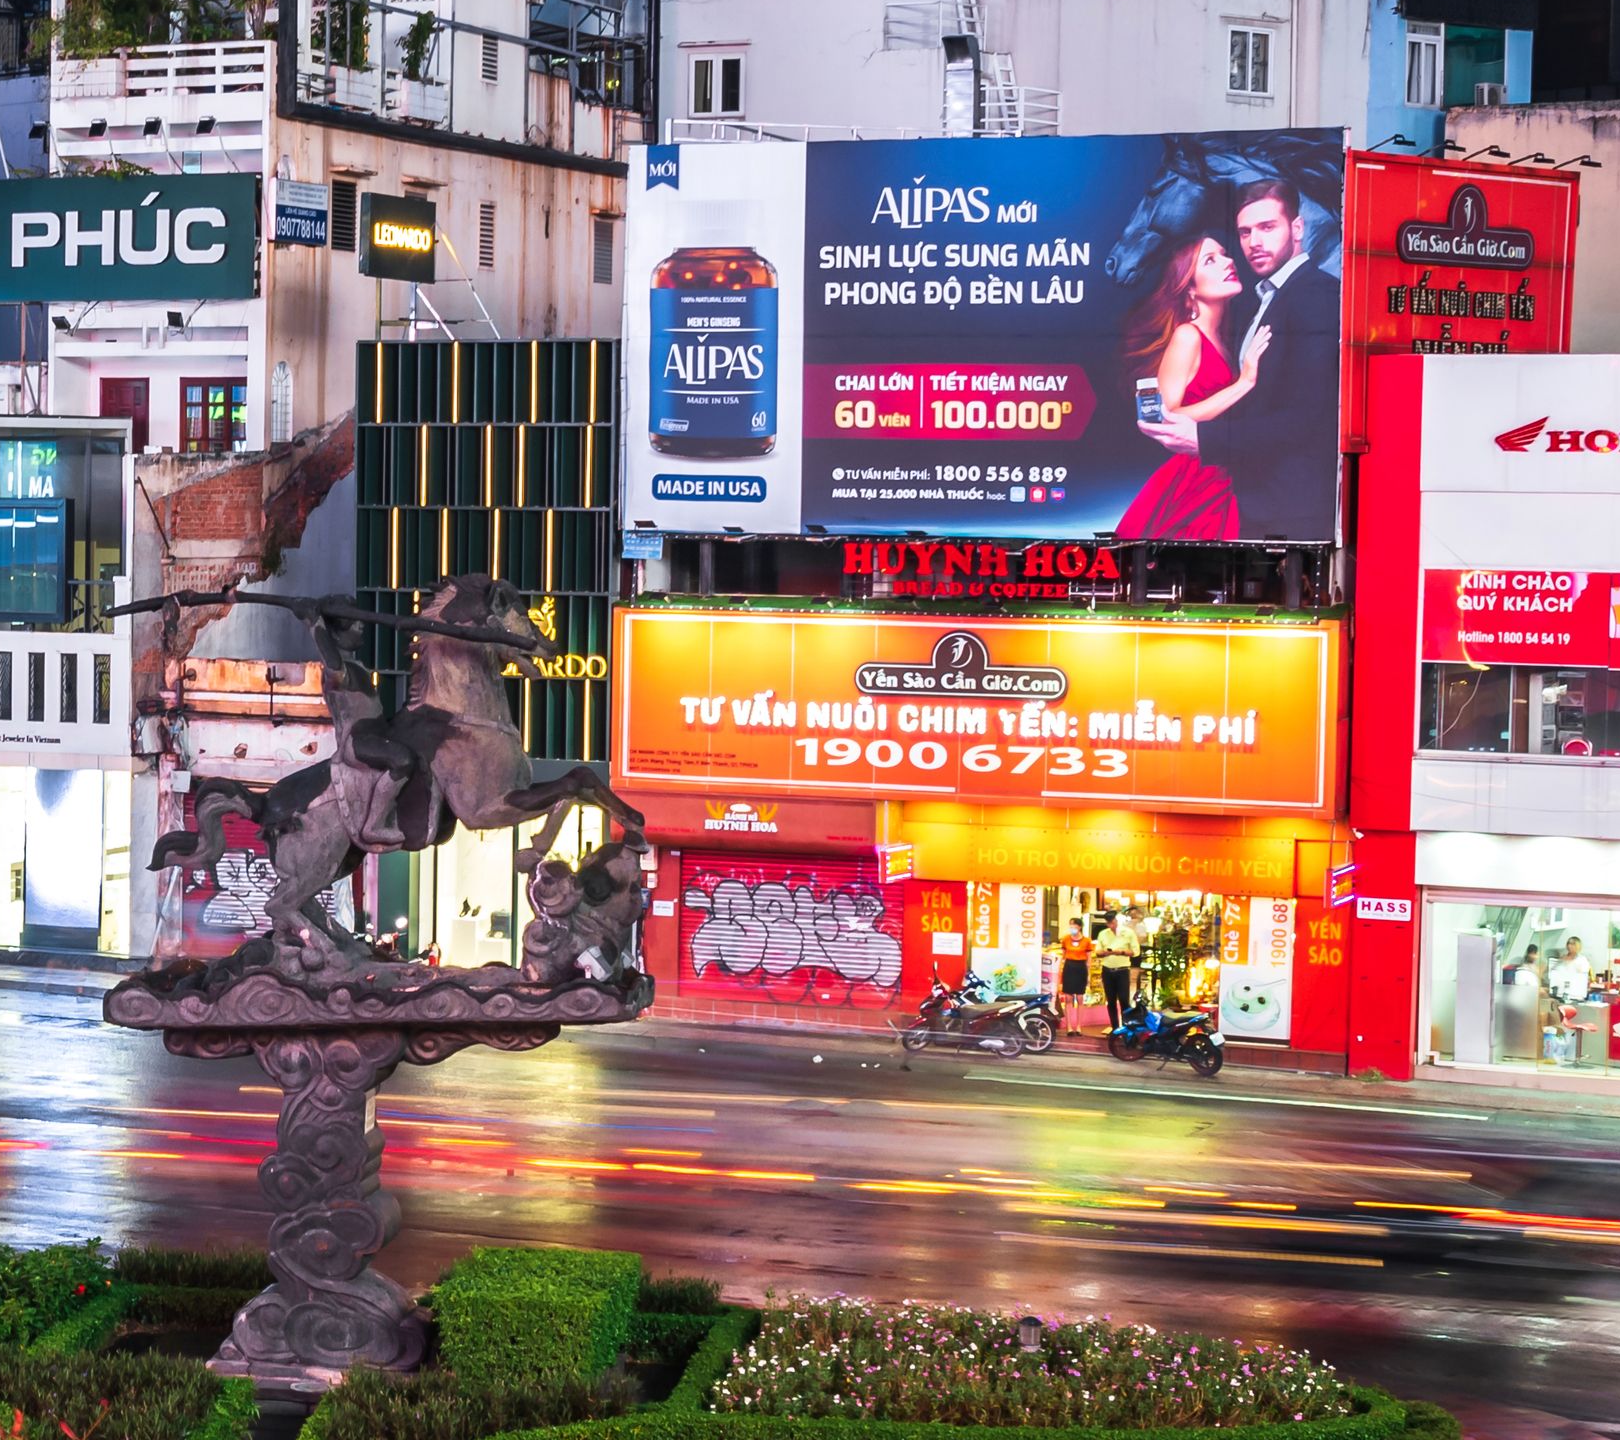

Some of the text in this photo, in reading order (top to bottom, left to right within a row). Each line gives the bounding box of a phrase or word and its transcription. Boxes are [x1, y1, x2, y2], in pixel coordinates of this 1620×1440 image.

[649, 159, 676, 177] MỚI
[10, 191, 226, 268] PHÚC
[276, 216, 326, 240] 0907788144
[819, 238, 1091, 274] SINH LỰC SUNG MÃN
[1406, 230, 1526, 260] Yến Sào Cần Giờ.Com
[824, 274, 1084, 310] PHONG ĐỘ BỀN LÂU
[835, 372, 913, 392] CHAI LỚN
[930, 371, 1068, 396] TIẾT KIỆM NGAY
[834, 400, 911, 429] 60 VIÊN
[657, 480, 761, 497] MADE IN USA
[891, 579, 1069, 600] BREAD & COFFEE
[1457, 592, 1574, 614] QUÝ KHÁCH
[1457, 631, 1570, 646] Hotline 1800 54 54 19
[862, 665, 1061, 697] Yến Sào Cần Giờ.Com
[2, 733, 25, 744] Jeweler
[26, 735, 34, 743] In
[35, 735, 61, 744] Vietnam
[794, 737, 948, 770] 1900
[961, 744, 1130, 779] 6733
[920, 886, 952, 910] YẾN
[1361, 898, 1409, 916] HASS
[920, 911, 953, 934] SÀO
[1309, 916, 1342, 941] YẾN
[1308, 941, 1343, 967] SÀO
